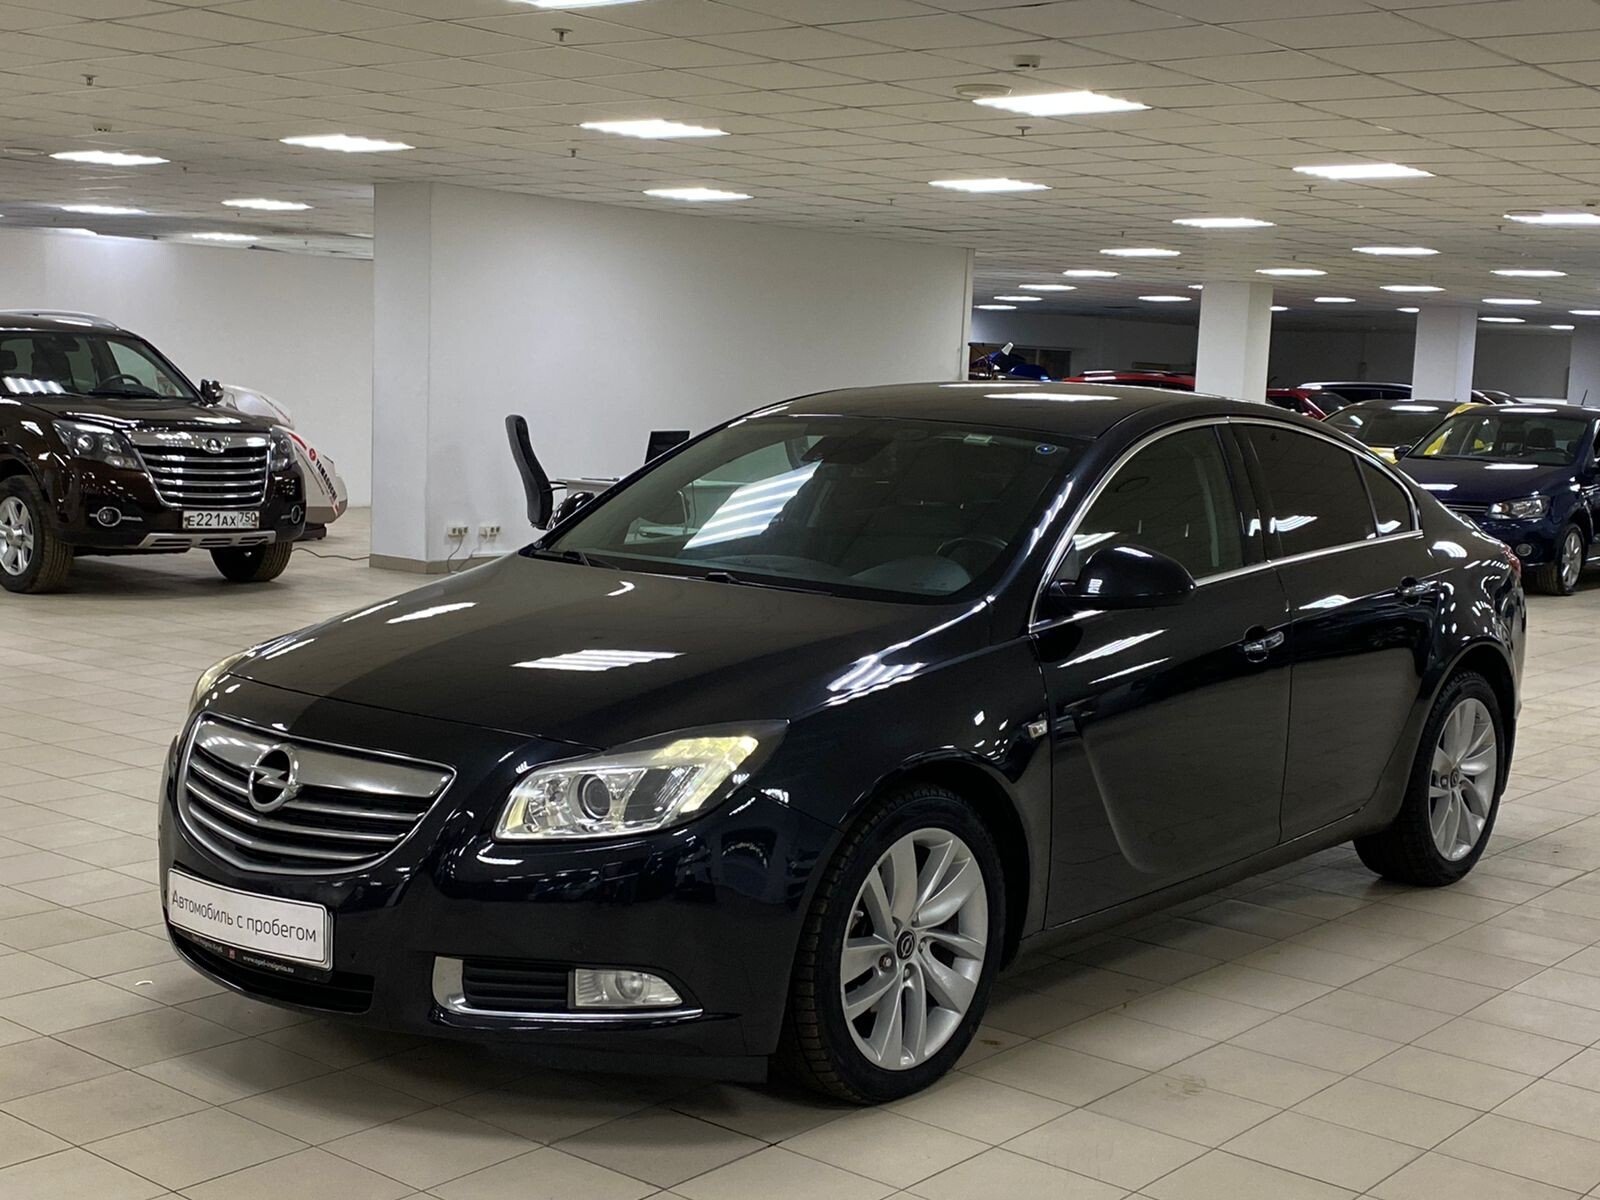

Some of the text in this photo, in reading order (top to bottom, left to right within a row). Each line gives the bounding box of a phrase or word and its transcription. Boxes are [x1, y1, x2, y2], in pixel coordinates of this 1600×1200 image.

[172, 890, 316, 942] Автомобиль с пробегом
